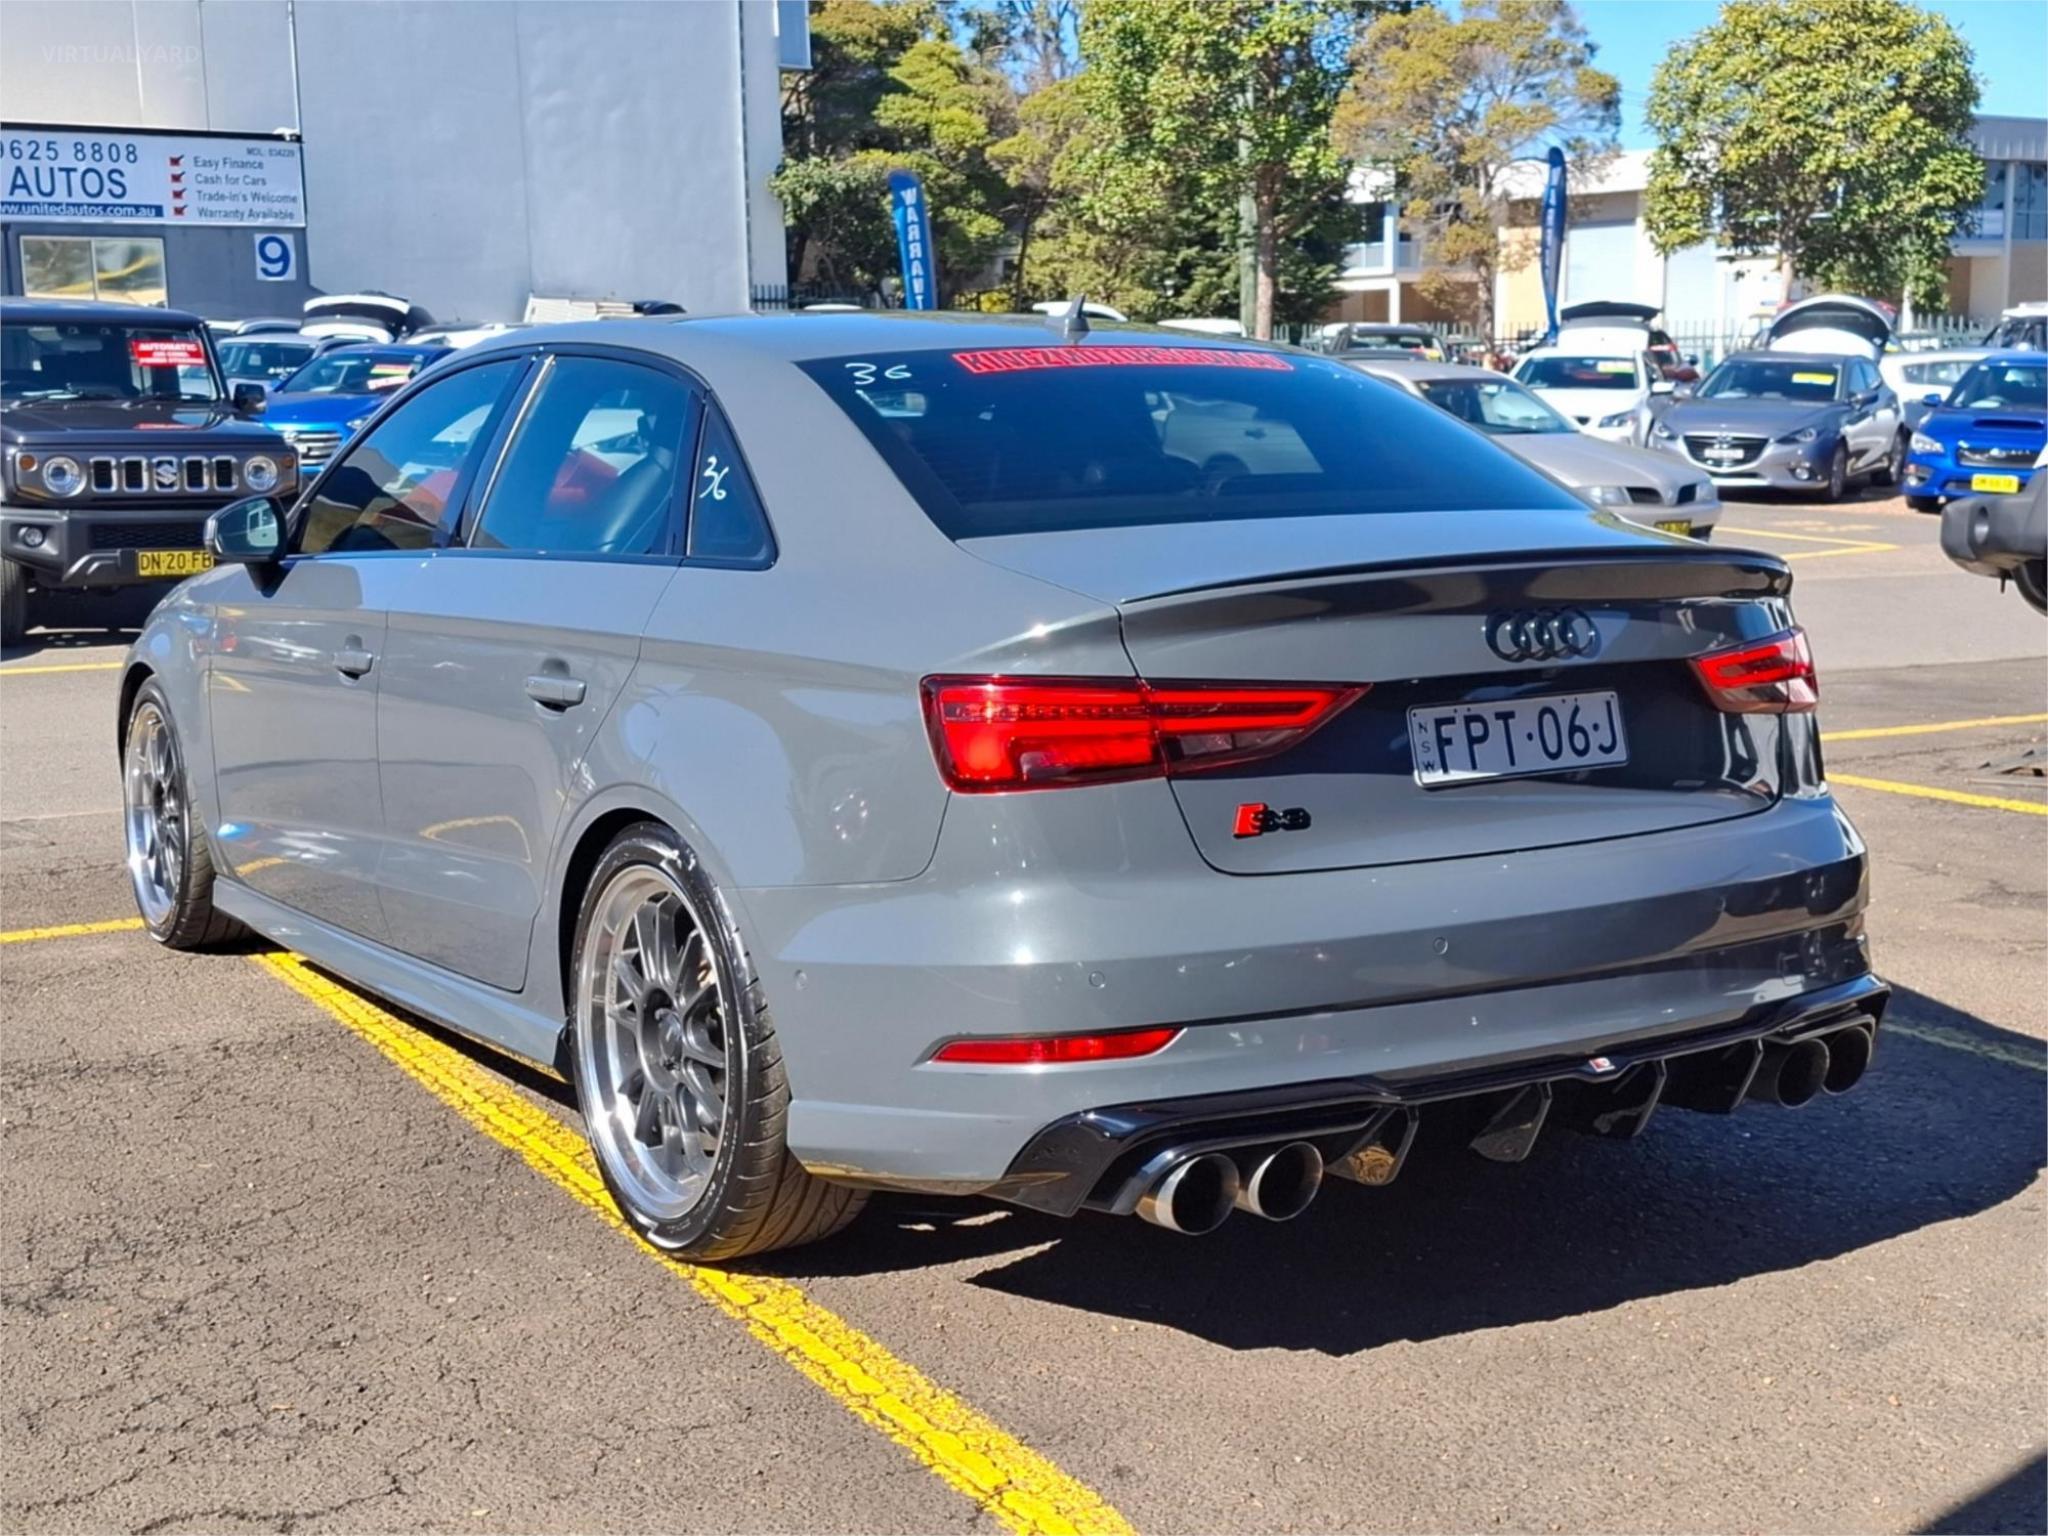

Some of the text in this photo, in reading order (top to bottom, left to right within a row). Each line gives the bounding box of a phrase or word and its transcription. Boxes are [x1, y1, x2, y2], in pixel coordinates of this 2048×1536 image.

[0, 139, 138, 164] 625 8808
[193, 156, 264, 171] Easy Finance
[9, 166, 127, 199] AUTOS
[195, 173, 267, 186] Cash for Cars
[250, 191, 297, 204] Welcome
[197, 206, 294, 221] Warranty Available
[258, 235, 291, 277] 9
[845, 362, 912, 385] 36
[700, 455, 729, 500] 36
